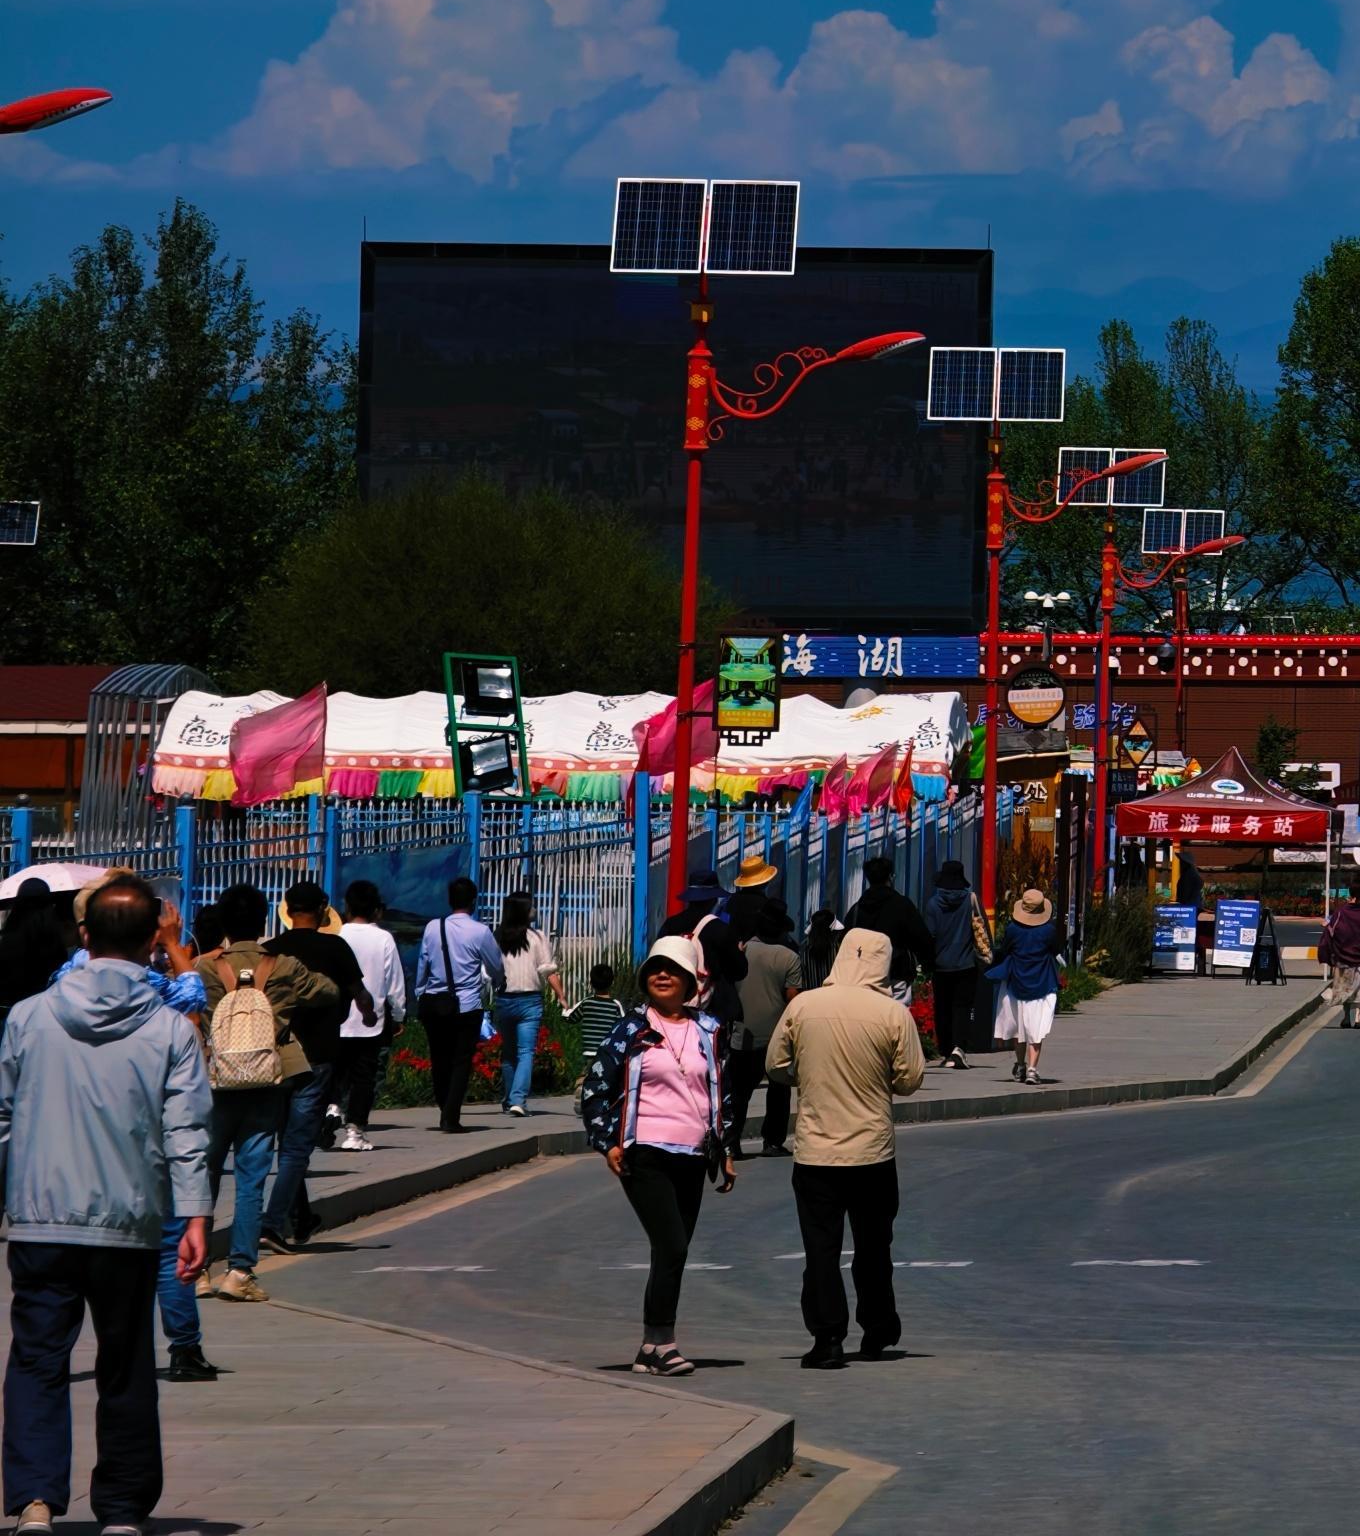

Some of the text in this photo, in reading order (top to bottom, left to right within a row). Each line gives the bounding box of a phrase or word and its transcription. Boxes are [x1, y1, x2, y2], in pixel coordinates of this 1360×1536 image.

[1148, 812, 1295, 837] 旅游服务站
